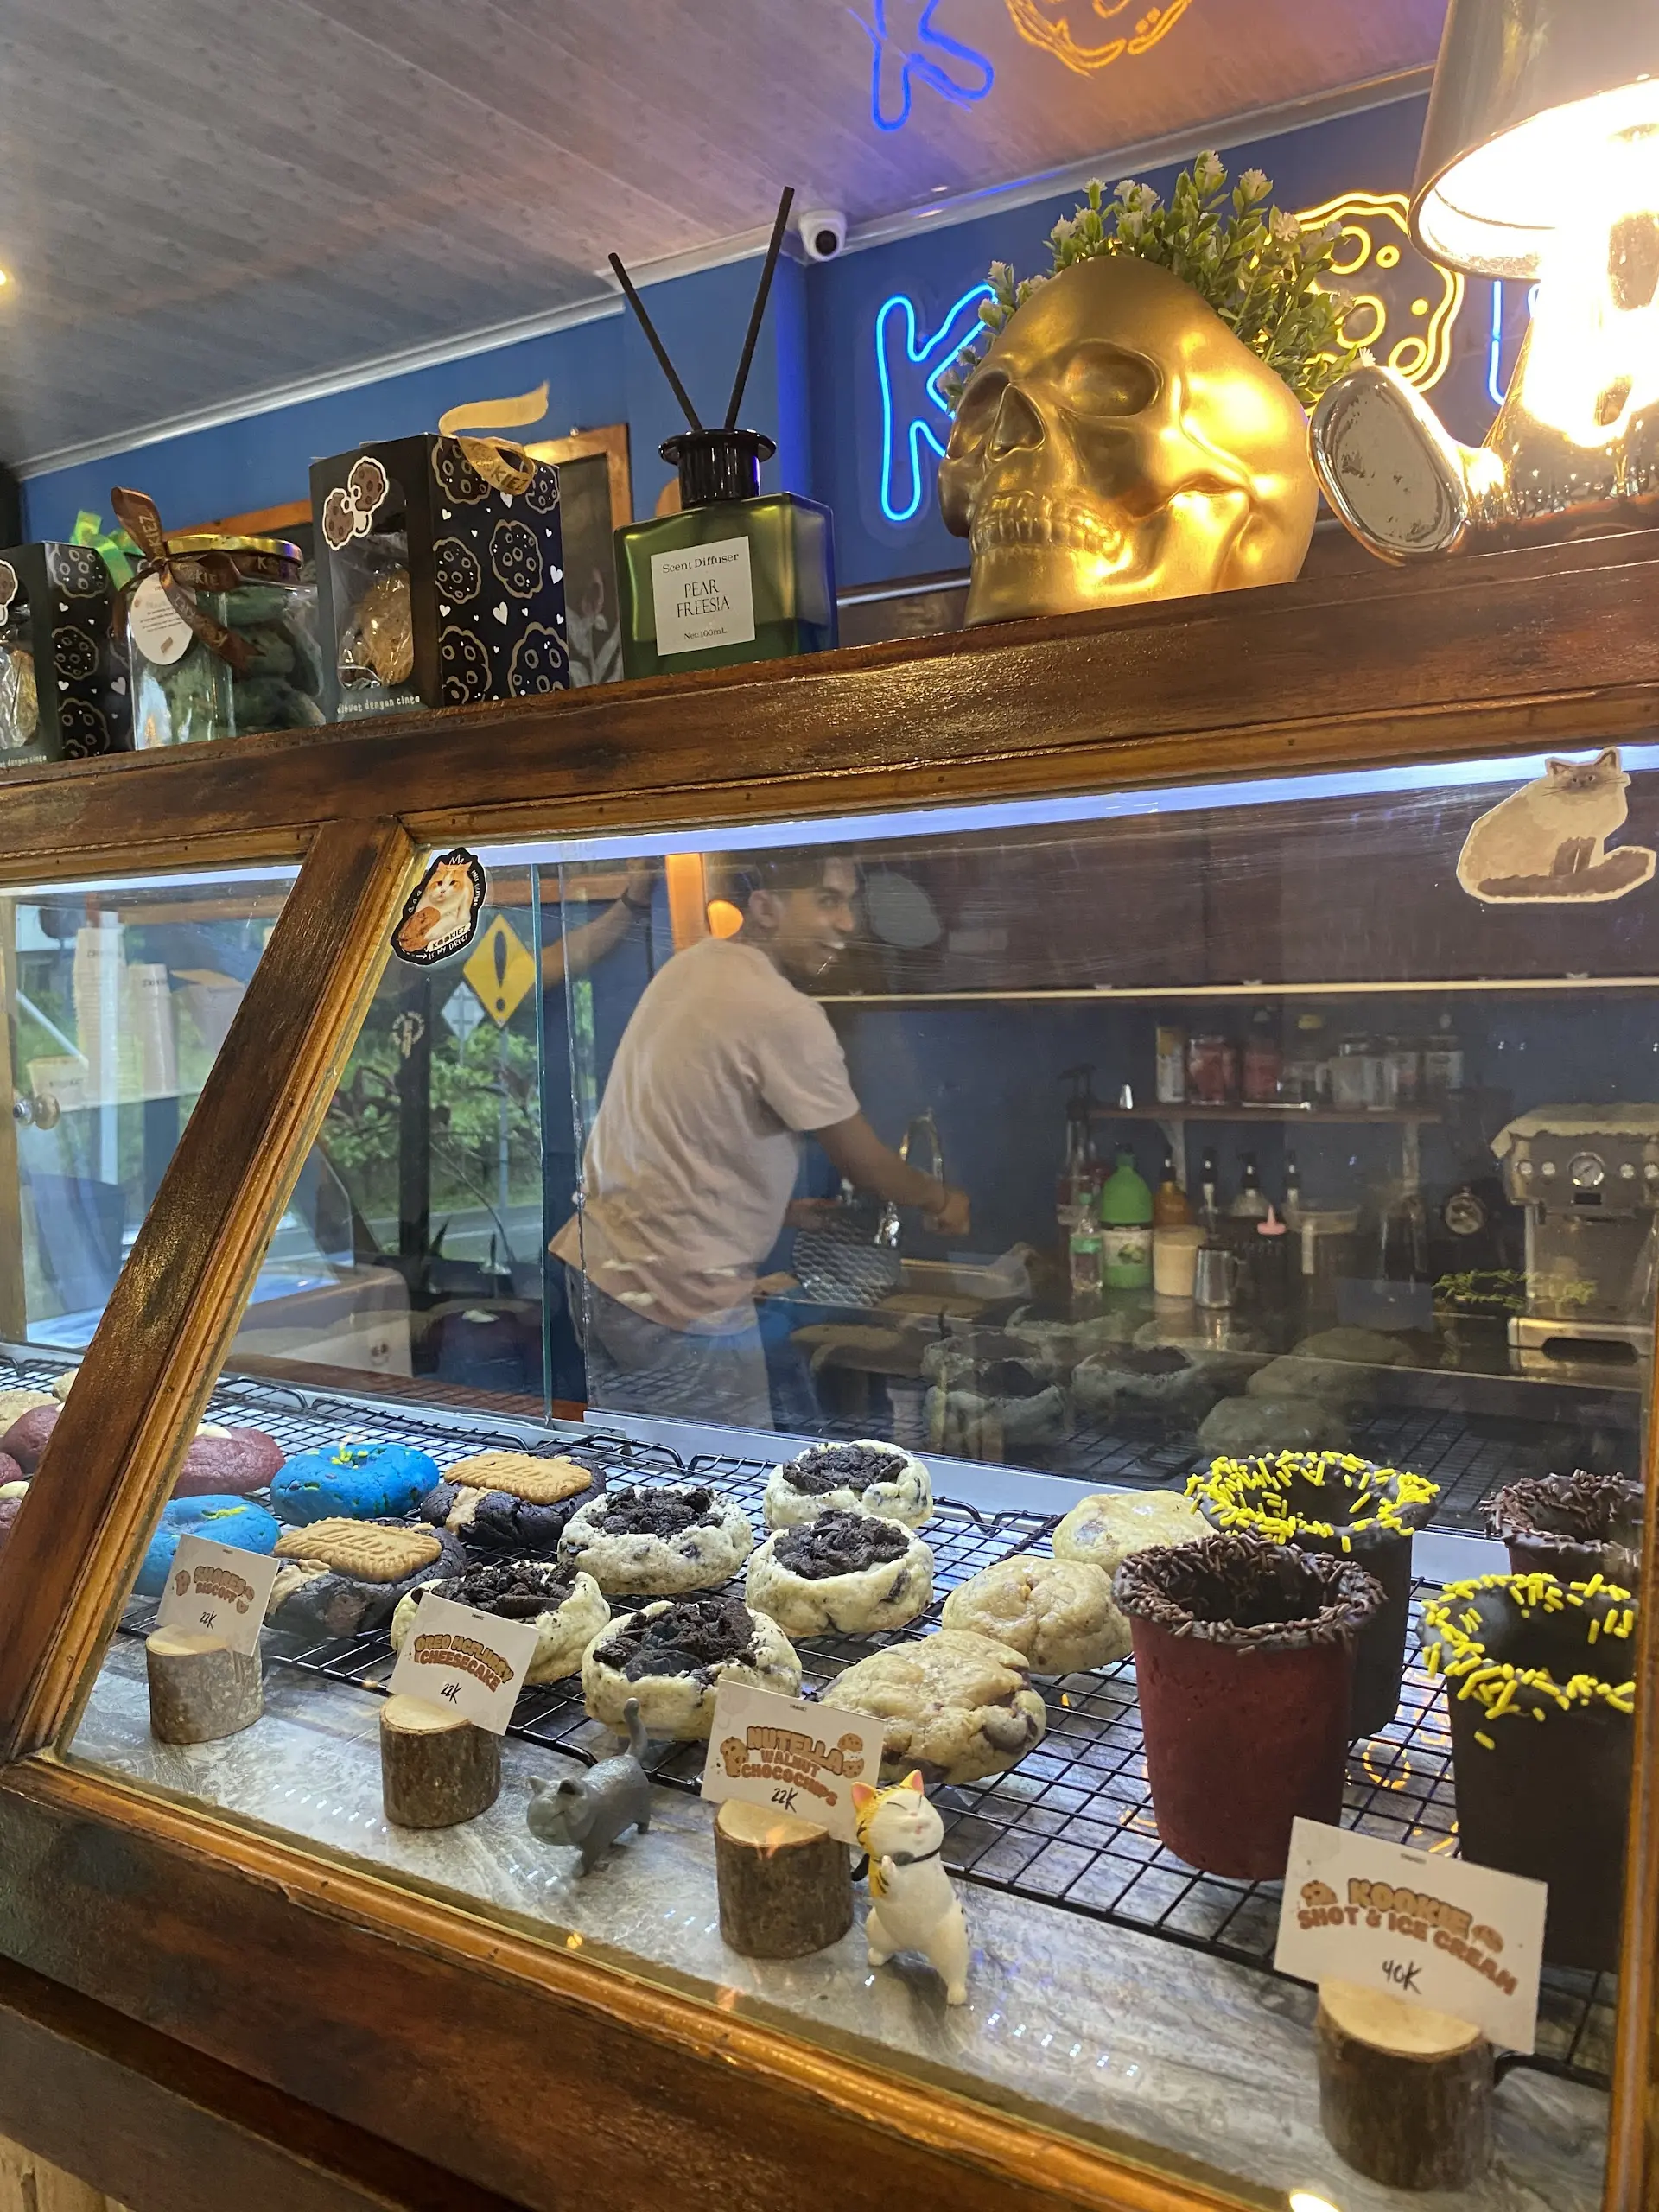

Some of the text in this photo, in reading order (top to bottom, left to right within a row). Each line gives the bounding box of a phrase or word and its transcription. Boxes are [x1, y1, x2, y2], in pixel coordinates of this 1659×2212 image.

[662, 553, 740, 574] Scent Diffuser
[683, 578, 720, 599] PEAR
[677, 595, 730, 618] FREESIA
[199, 1611, 218, 1630] 22K
[414, 1634, 452, 1652] OREO
[420, 1649, 502, 1693] CHEESECAKE
[440, 1682, 462, 1704] 22K
[746, 1726, 844, 1776] NUTELLA
[760, 1748, 821, 1778] WALNUT
[741, 1763, 838, 1807] CHOCOCHIPS
[771, 1787, 798, 1814] 22K
[1347, 1877, 1473, 1941] KOOKIE
[1297, 1906, 1518, 1996] SHOT & ICE CREAM
[1382, 1960, 1423, 1995] 40K
